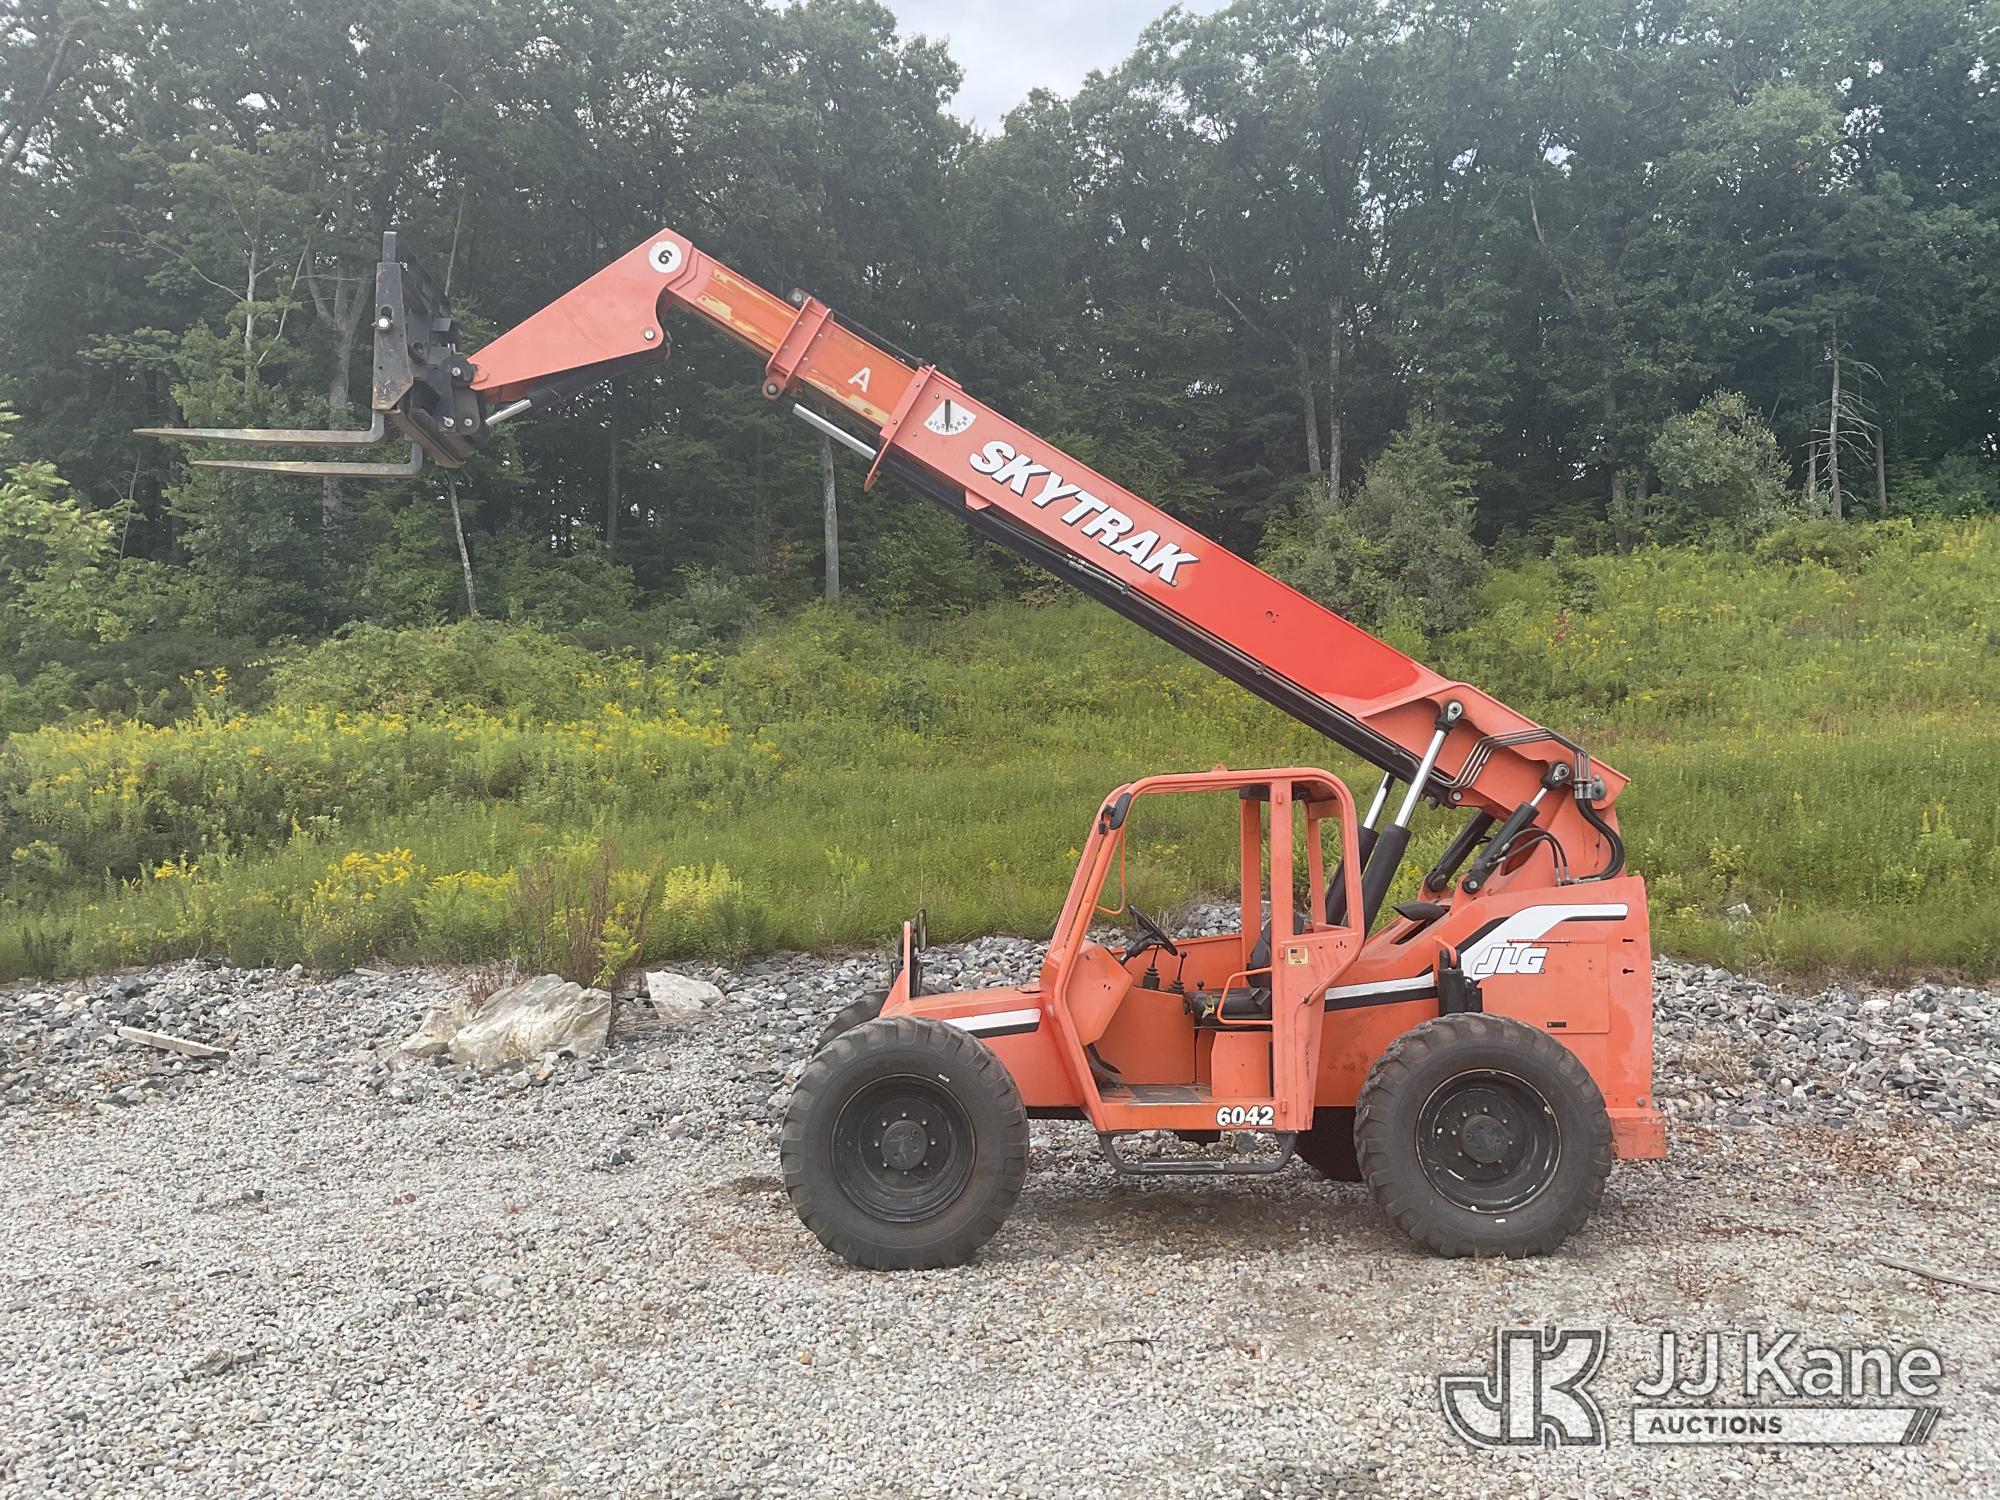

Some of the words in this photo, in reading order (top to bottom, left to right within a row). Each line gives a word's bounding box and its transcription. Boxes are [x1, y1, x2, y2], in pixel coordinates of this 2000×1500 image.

[658, 249, 673, 265] 6
[848, 366, 872, 393] A
[969, 440, 1200, 584] SKYTRAK
[1474, 946, 1549, 974] JLG
[1216, 1105, 1274, 1126] 6042
